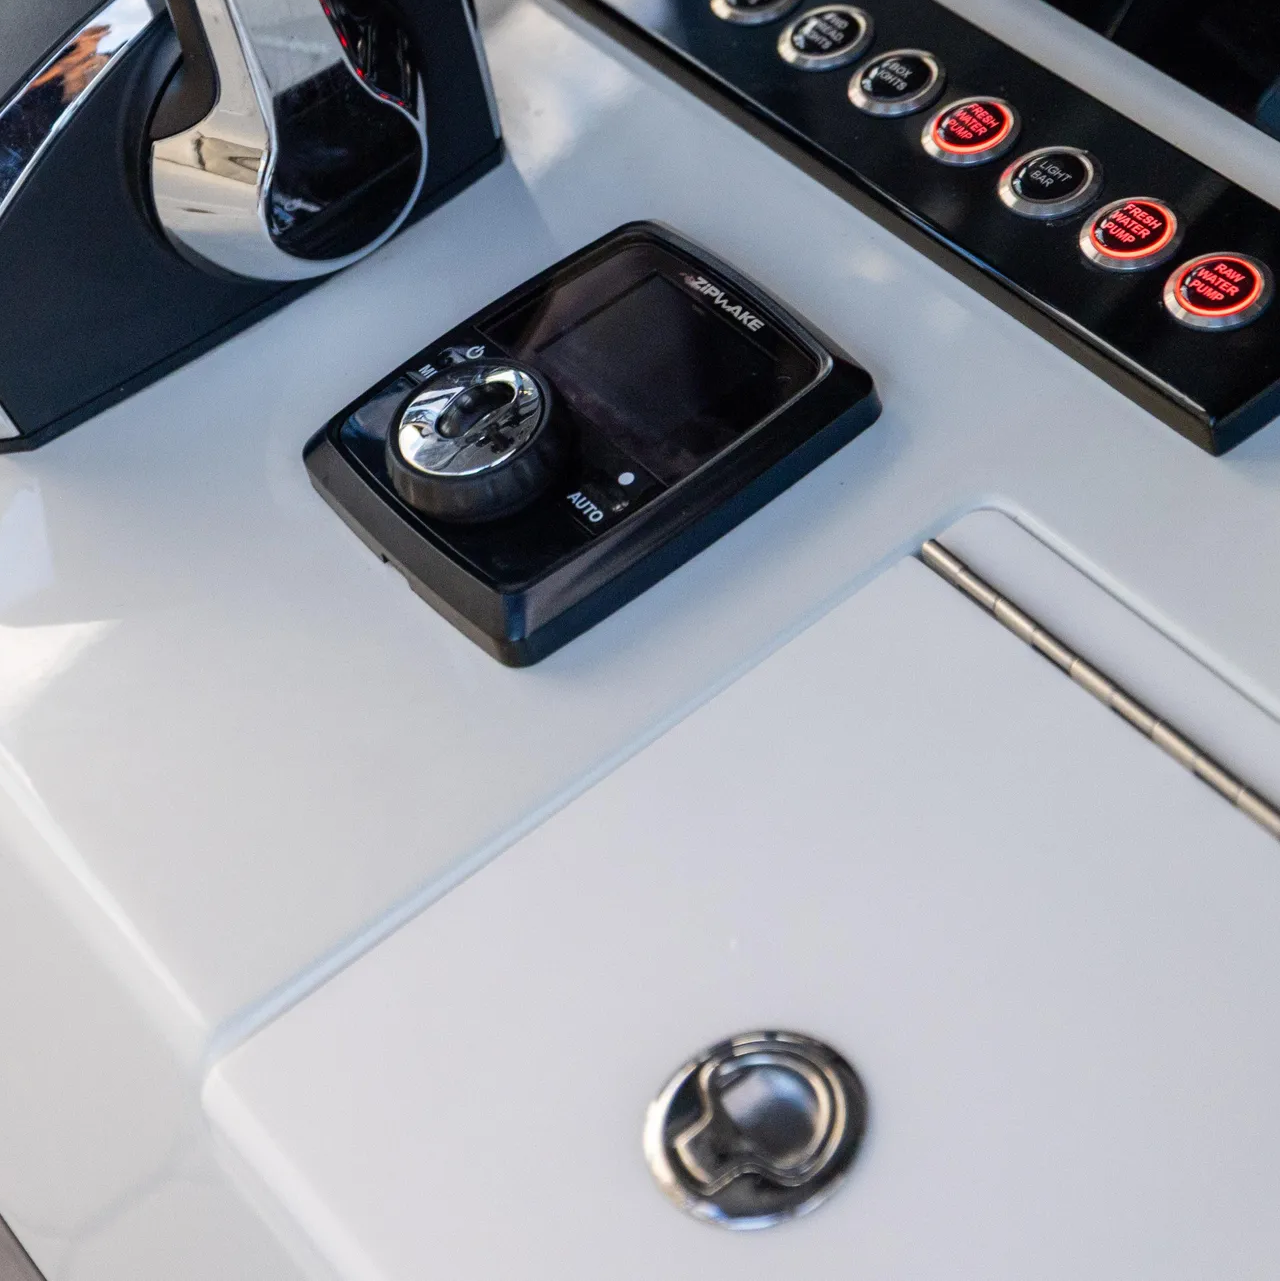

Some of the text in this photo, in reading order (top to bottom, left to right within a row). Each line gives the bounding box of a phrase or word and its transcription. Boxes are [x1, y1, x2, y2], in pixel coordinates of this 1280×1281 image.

[954, 109, 988, 136] WATER
[967, 102, 1000, 129] FRESH
[947, 118, 973, 140] PUMP
[1030, 169, 1055, 188] BAR
[1039, 160, 1073, 183] LIGHT
[1110, 210, 1151, 239] WATER
[1123, 203, 1162, 230] FRESH
[1104, 221, 1136, 243] PUMP
[1197, 268, 1240, 297] WATER
[1214, 263, 1246, 283] RAW
[1188, 279, 1225, 301] PUMP
[566, 491, 604, 523] AUTO
